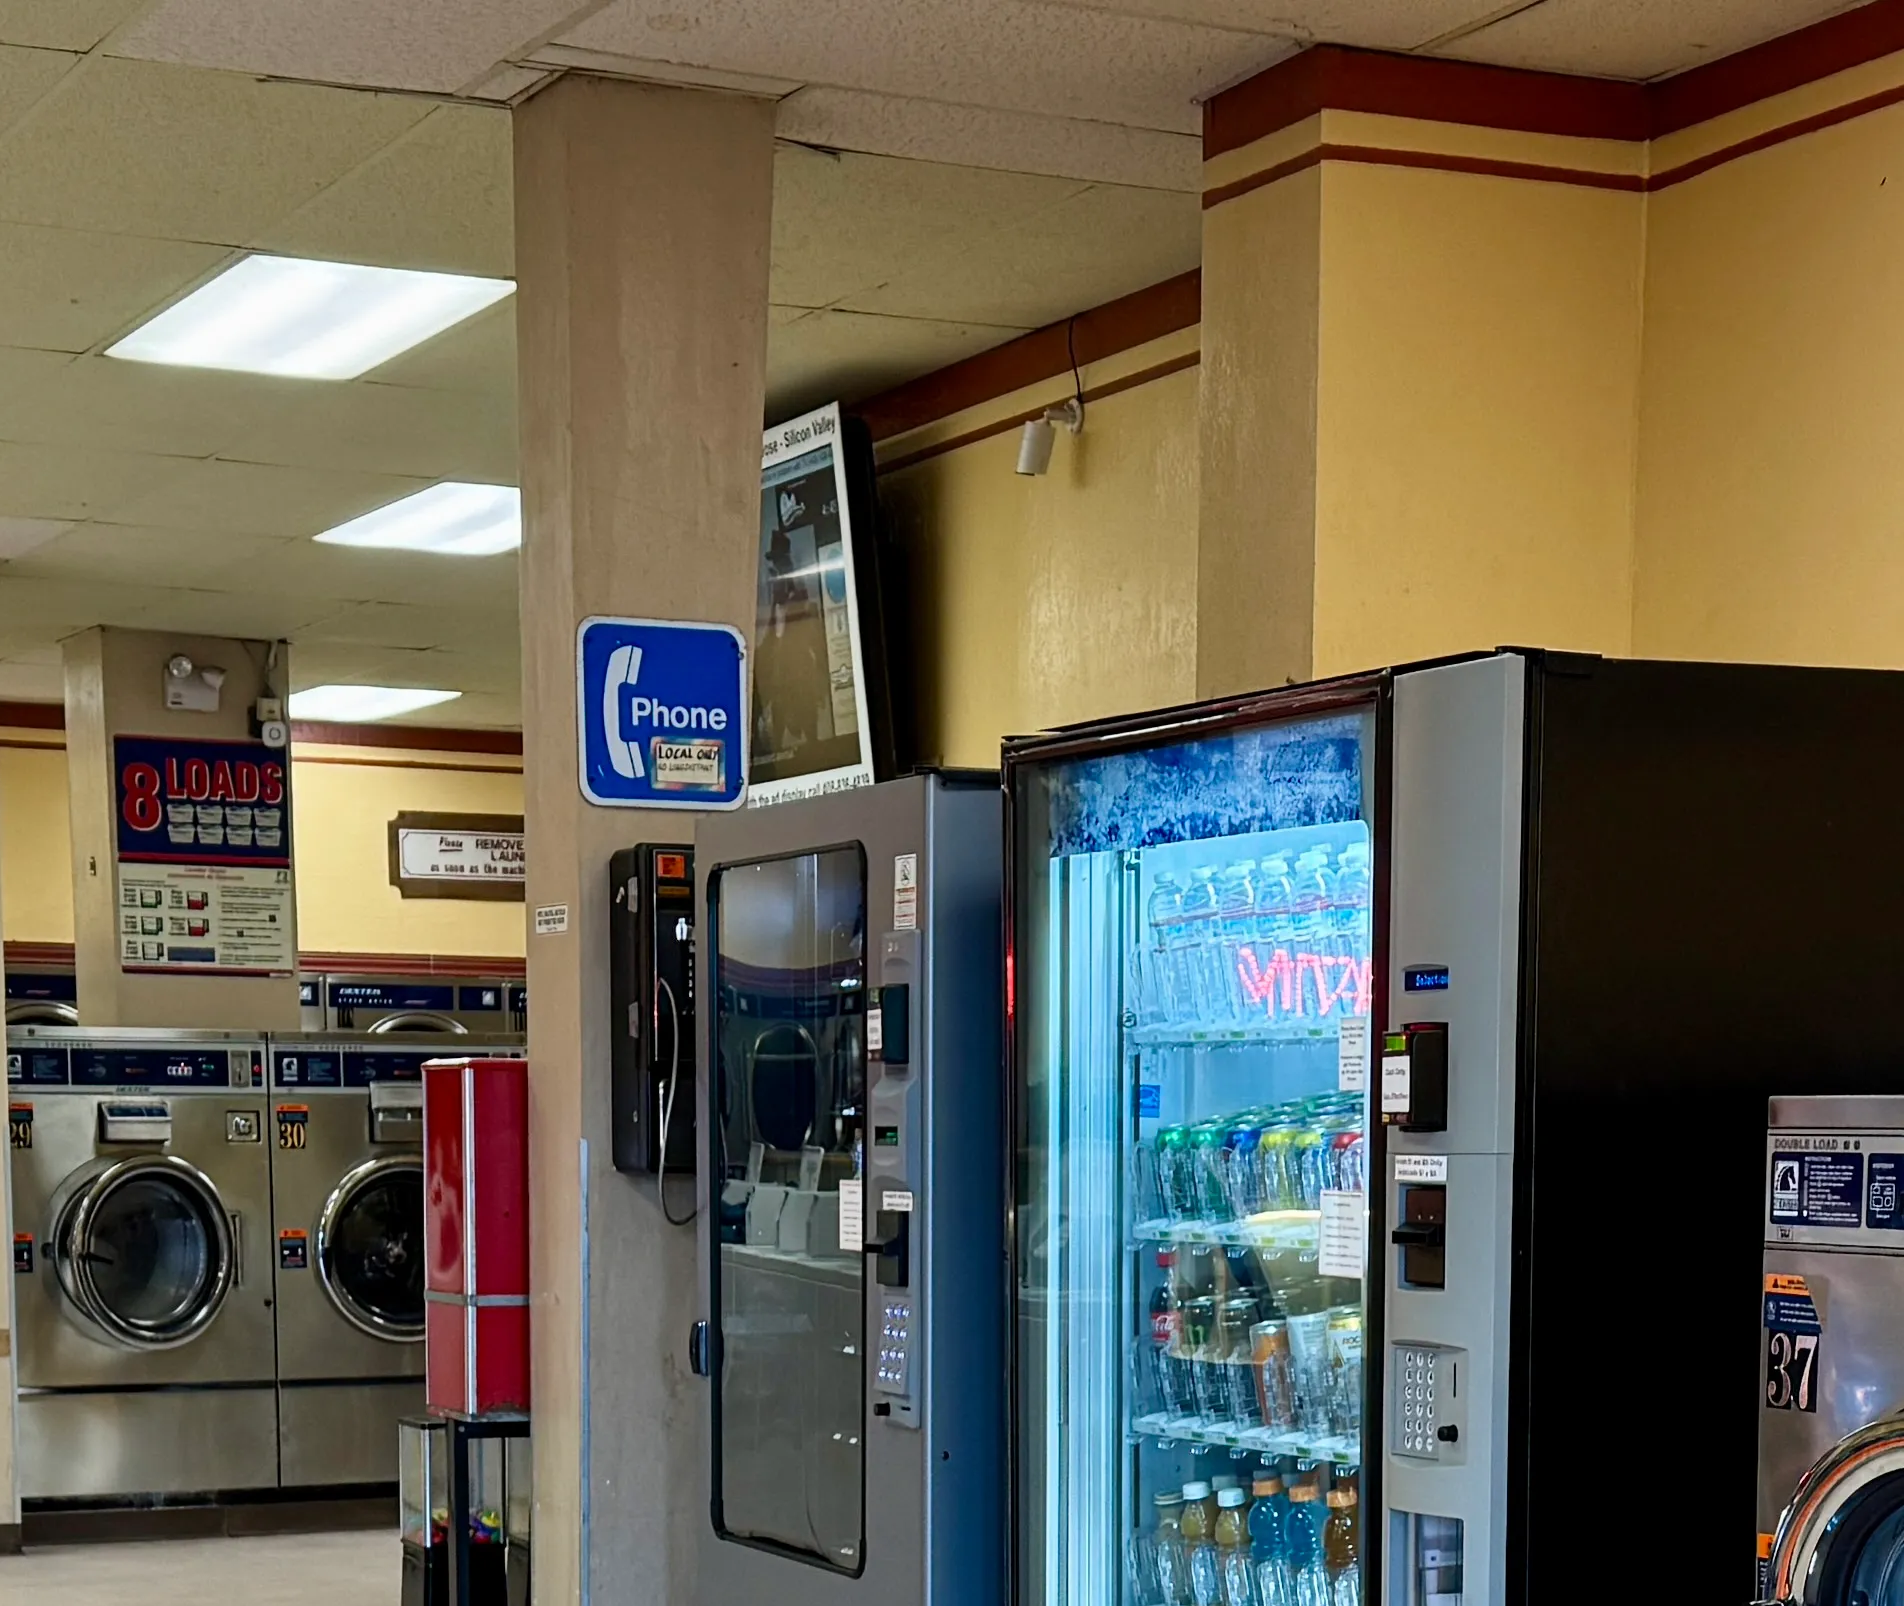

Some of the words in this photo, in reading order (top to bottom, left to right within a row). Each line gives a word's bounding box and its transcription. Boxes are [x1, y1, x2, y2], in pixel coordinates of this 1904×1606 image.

[783, 426, 812, 448] Silicon
[812, 415, 836, 437] Valley
[631, 696, 728, 731] Phone
[658, 745, 693, 759] LOCAL
[122, 762, 162, 831] 8
[165, 757, 284, 804] LOADS
[475, 838, 524, 851] REMOVE
[490, 850, 525, 862] LAUN
[279, 1122, 306, 1148] 30
[1774, 1137, 1810, 1150] DOUBLE
[1813, 1138, 1838, 1150] LOAD
[1767, 1332, 1818, 1410] 37
